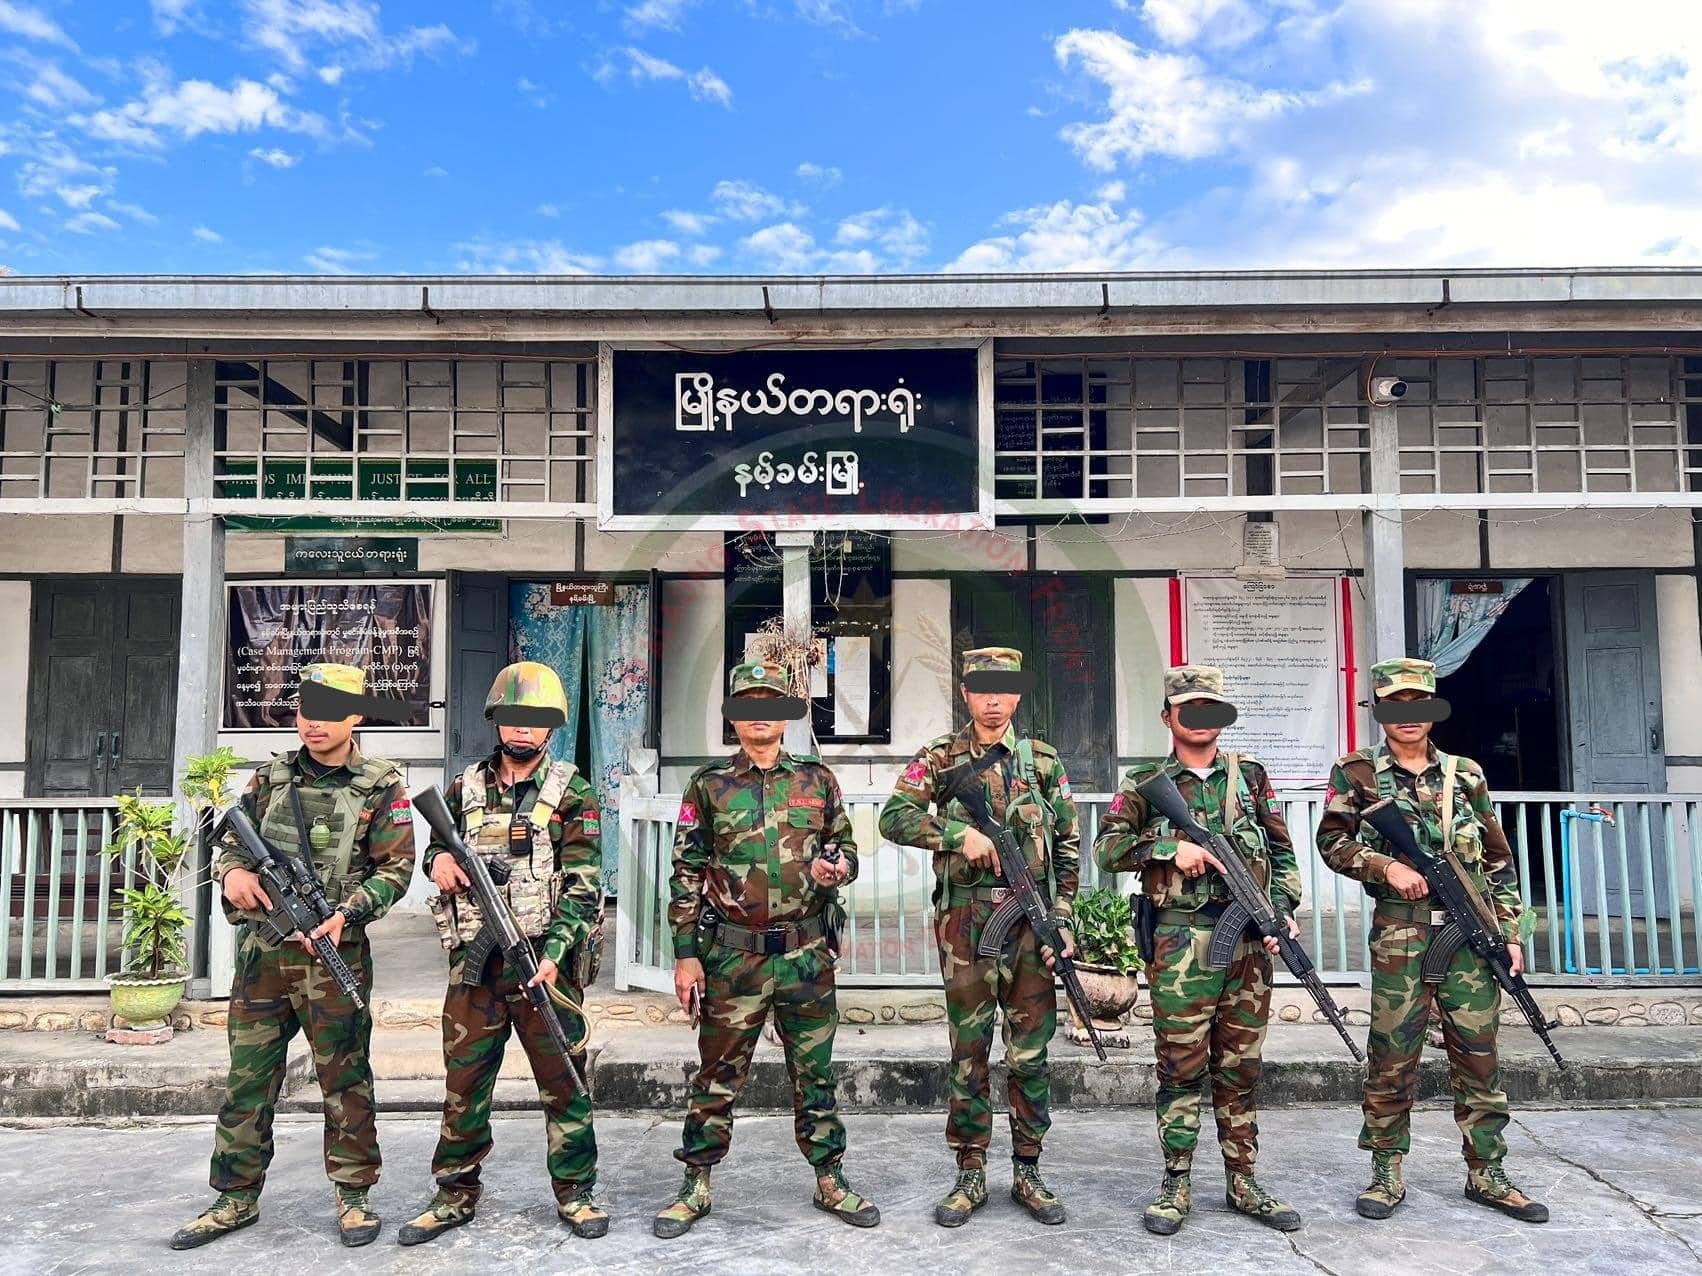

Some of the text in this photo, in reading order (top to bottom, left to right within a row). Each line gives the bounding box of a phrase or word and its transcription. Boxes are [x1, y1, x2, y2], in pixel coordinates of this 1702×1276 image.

[675, 372, 922, 433] မြို့နယ်တရားရုံး
[465, 473, 491, 485] ALL
[237, 646, 264, 658] (Case
[265, 646, 326, 657] Management
